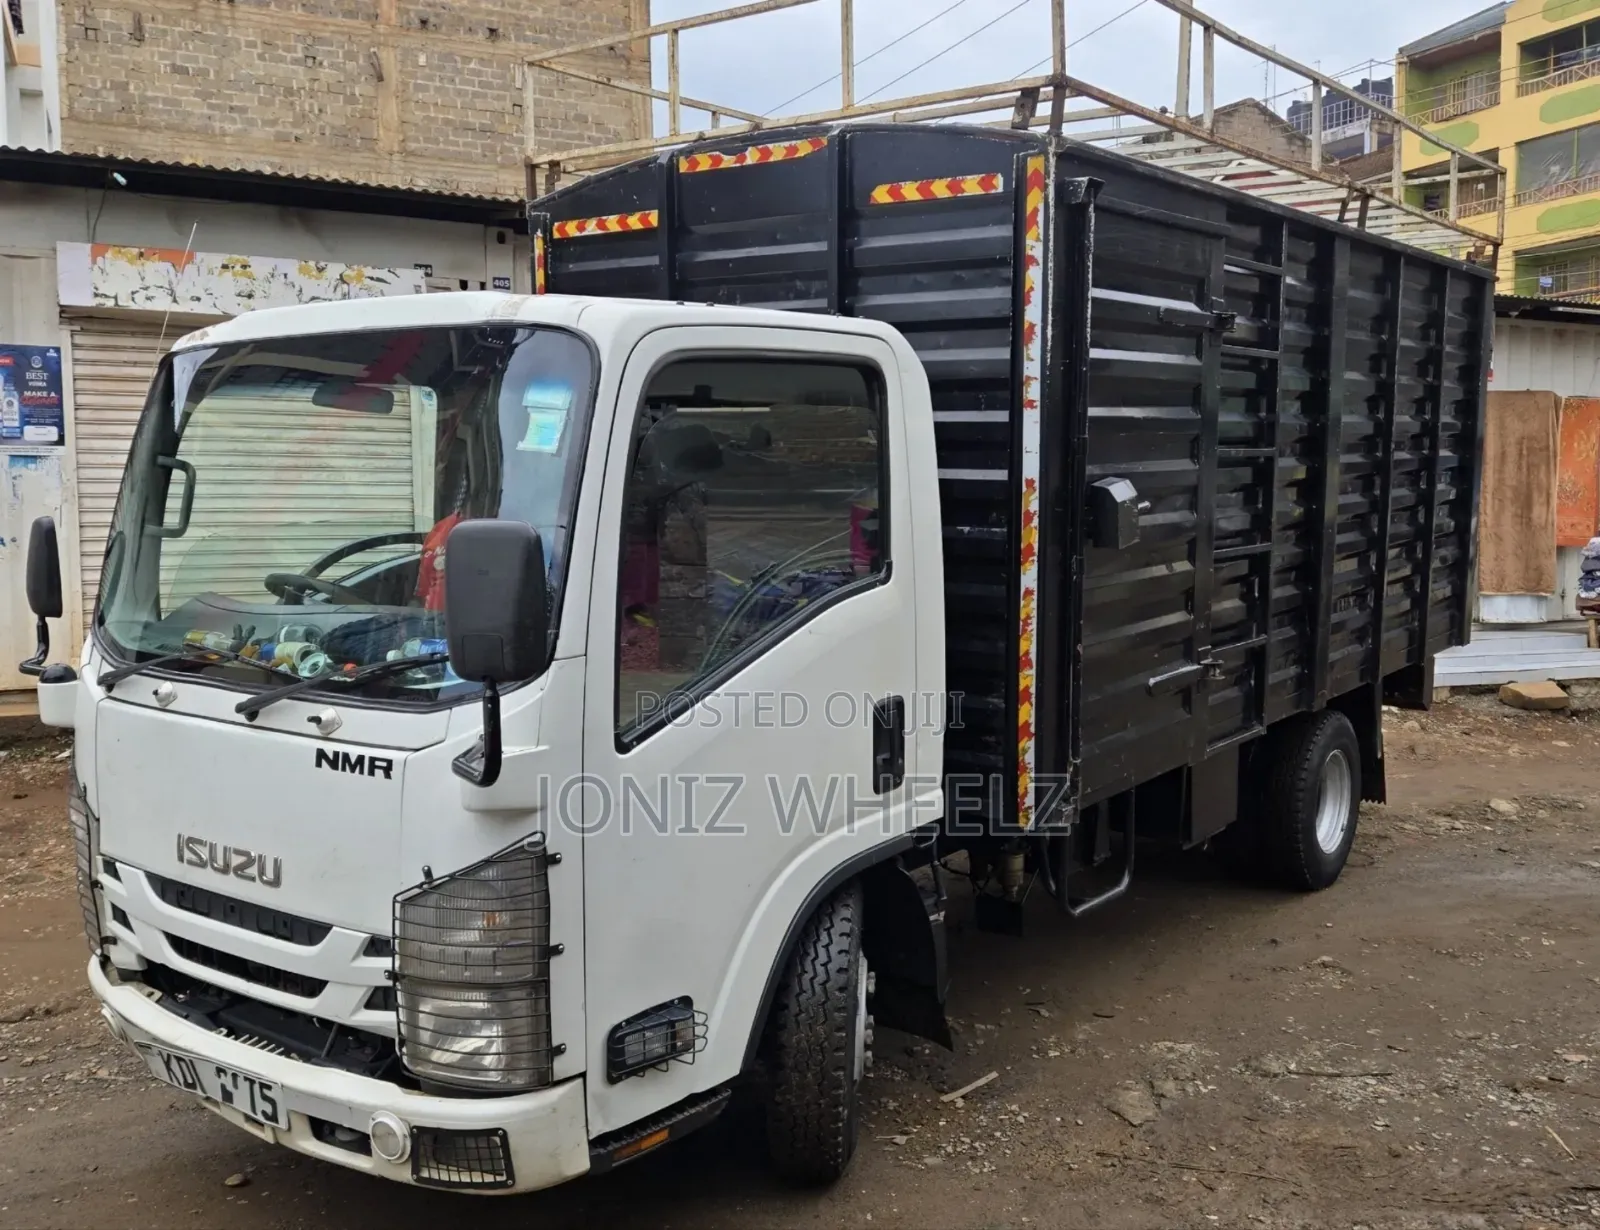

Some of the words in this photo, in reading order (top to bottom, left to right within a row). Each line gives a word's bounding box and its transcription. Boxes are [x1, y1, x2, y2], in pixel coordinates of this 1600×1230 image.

[493, 279, 510, 288] 405
[25, 372, 49, 380] BEST
[315, 748, 394, 780] NMR
[176, 832, 282, 889] ISUZU
